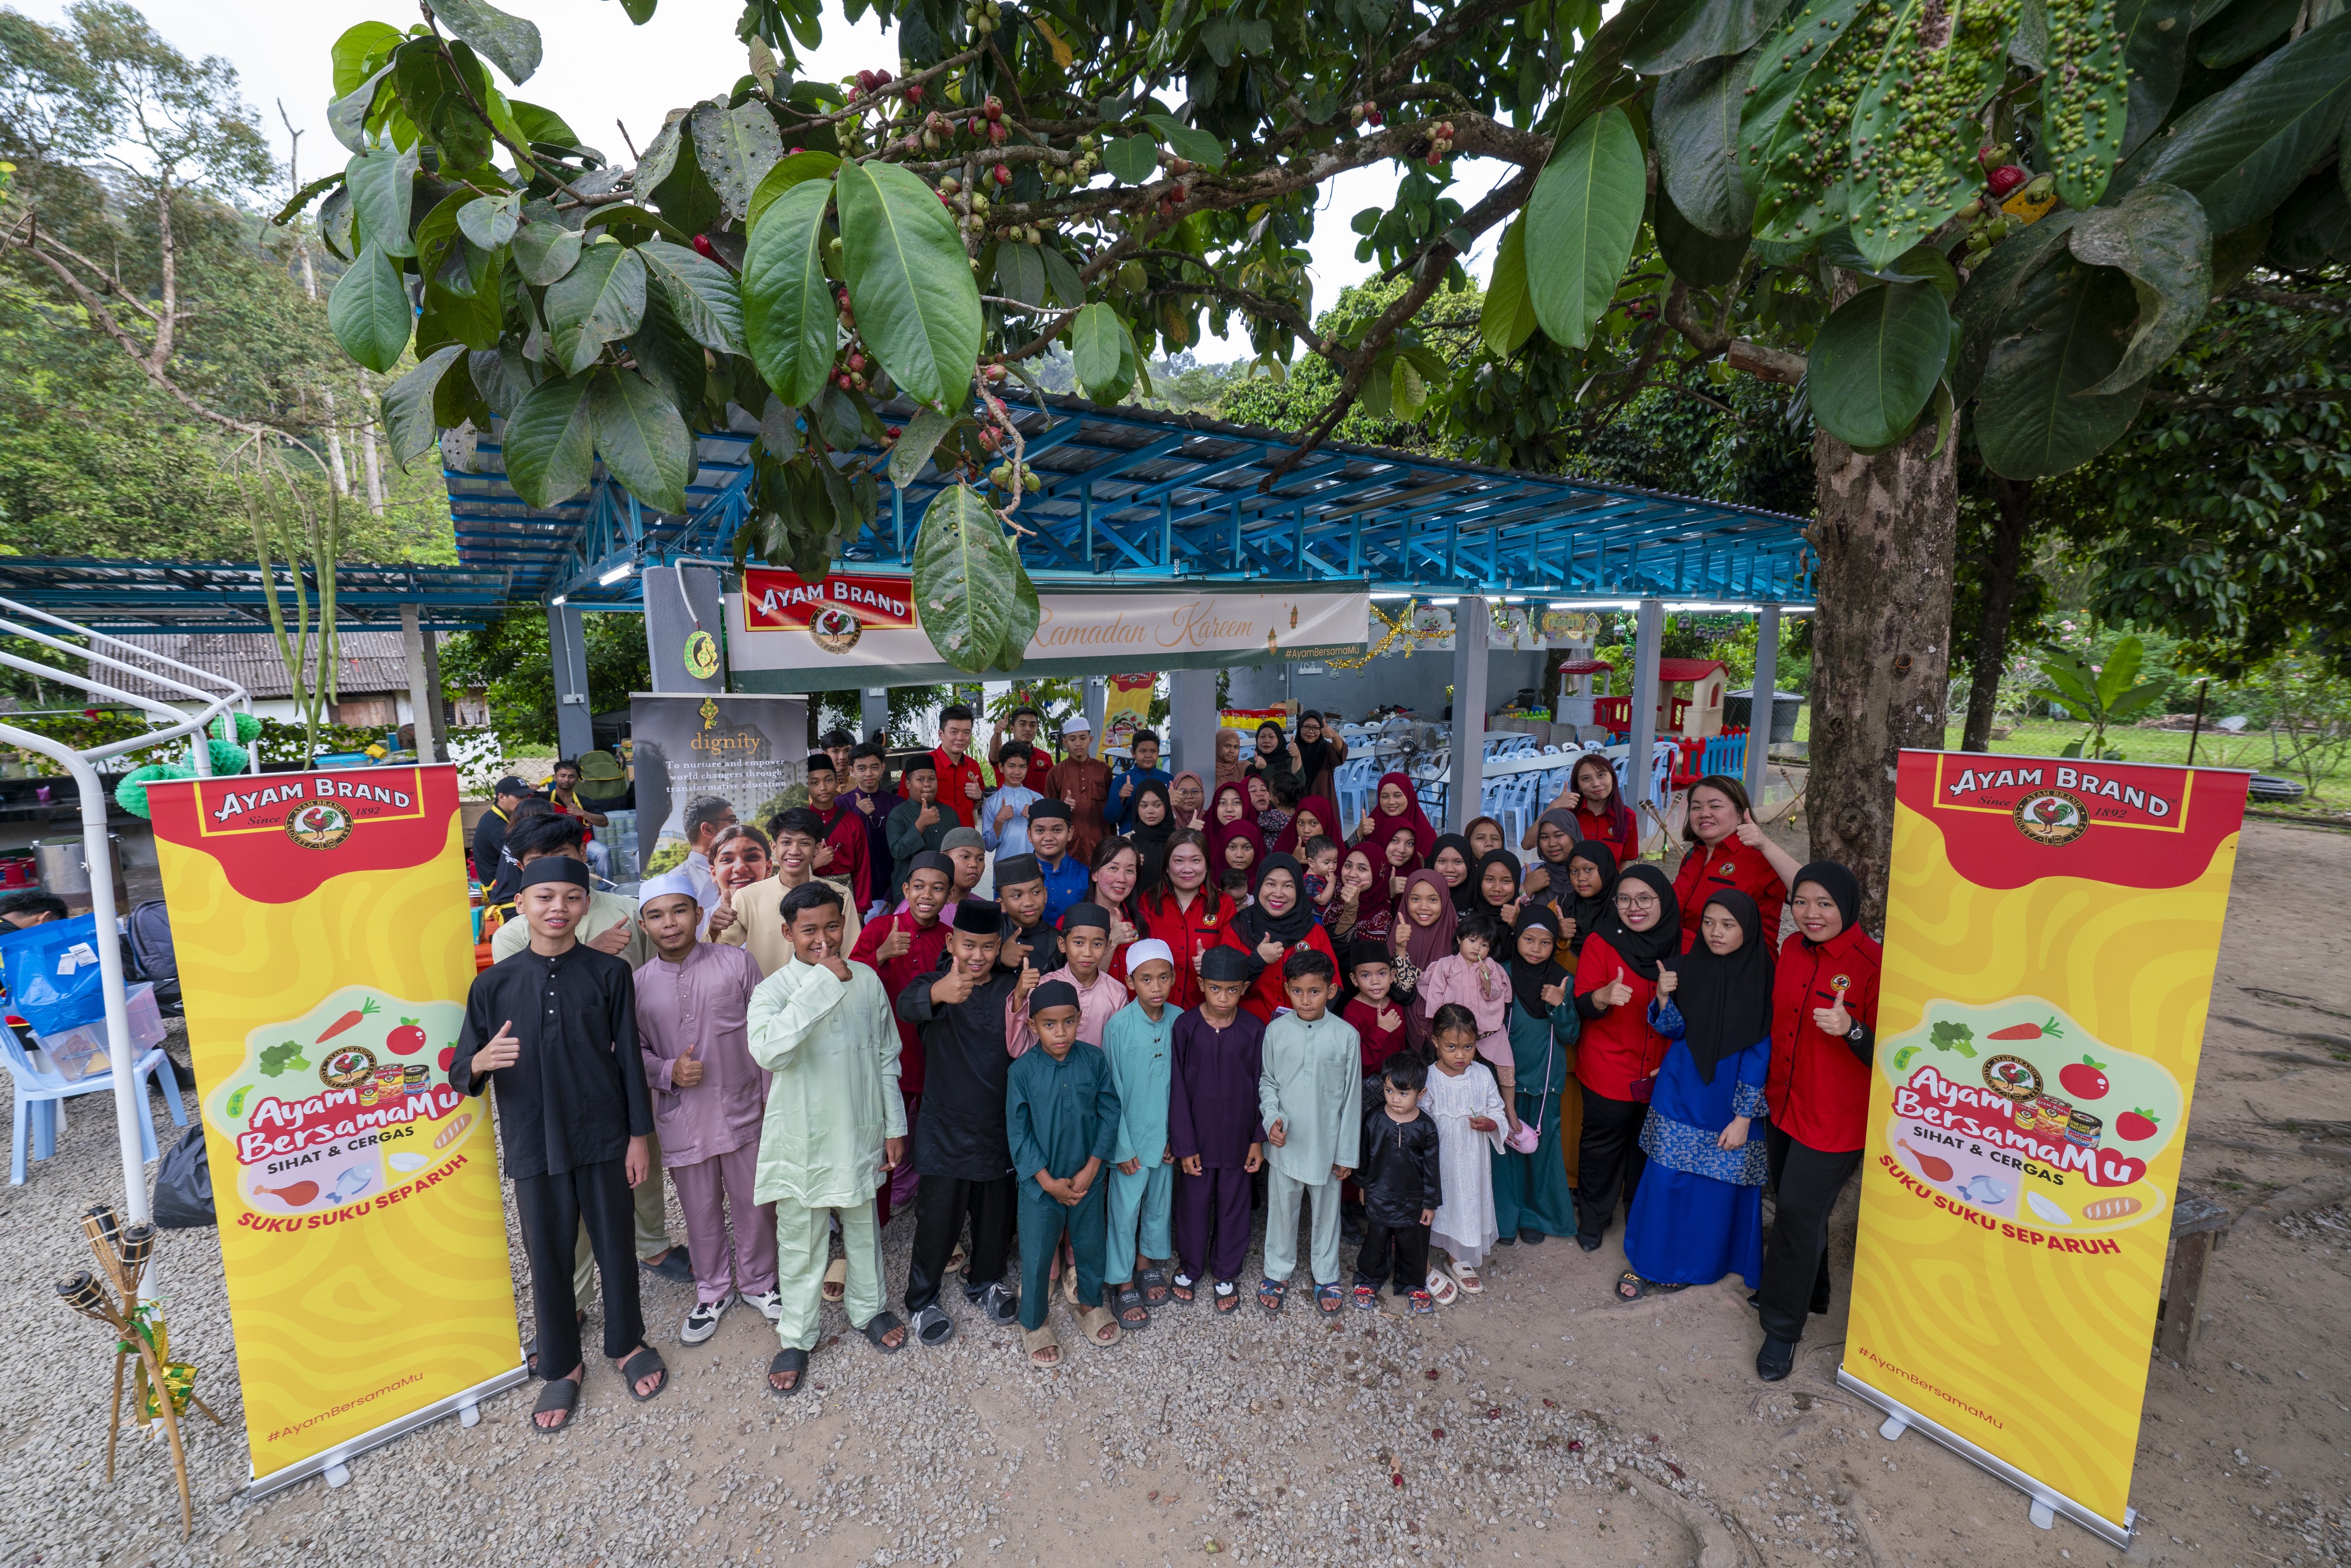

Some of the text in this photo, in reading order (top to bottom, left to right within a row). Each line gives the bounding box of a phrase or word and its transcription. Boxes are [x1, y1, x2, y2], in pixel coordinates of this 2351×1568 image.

[757, 581, 906, 618] AYAM BRAND
[817, 604, 855, 615] AYAM BRAND
[782, 614, 807, 623] Since
[1035, 599, 1254, 647] Ramadan Kareem
[811, 625, 827, 648] CLOUET
[851, 627, 860, 644] 1892
[1285, 646, 1359, 660] #AyamBersamaMu
[691, 733, 760, 755] dignity
[745, 759, 785, 767] empower
[670, 769, 782, 782] world changers through
[666, 782, 739, 793] transformative
[1949, 767, 2045, 796] AYAM
[2057, 766, 2170, 817] BRAND
[213, 782, 305, 824] AYAM
[313, 778, 411, 808] BRAND
[294, 801, 344, 815] AYAM BRAND
[1978, 795, 2127, 819] Since 1892
[2026, 791, 2082, 808] AYAM BRAND
[247, 807, 380, 825] Since 1892
[2016, 811, 2033, 836] CLOUET
[287, 824, 308, 846] CLOUET
[341, 822, 351, 839] 1892
[2070, 821, 2086, 839] 1892
[327, 1049, 344, 1062] AYAM
[2015, 1058, 2036, 1075] BRAND
[322, 1071, 339, 1088] CLOUET
[1984, 1068, 1999, 1090] CLOUET
[1912, 1068, 2013, 1118] Ayam
[2027, 1086, 2040, 1099] 1892
[253, 1088, 357, 1130] Ayam
[240, 1090, 459, 1162] BersamaMu
[1896, 1088, 2132, 1183] BersamaMu
[2070, 1124, 2089, 1133] MAYONES
[267, 1126, 414, 1175] SIHAT & CERGAS
[1913, 1126, 2064, 1187] SIHAT & CERGAS
[237, 1153, 469, 1233] SUKU SUKU SEPARUH
[1879, 1154, 2122, 1255] SUKU SUKU SEPARUH
[1144, 1271, 1160, 1279] SMILE
[1122, 1292, 1139, 1301] SMILE
[1858, 1346, 2003, 1430] #AyamBersamaMu
[267, 1372, 423, 1443] #AyamBersamaMu
